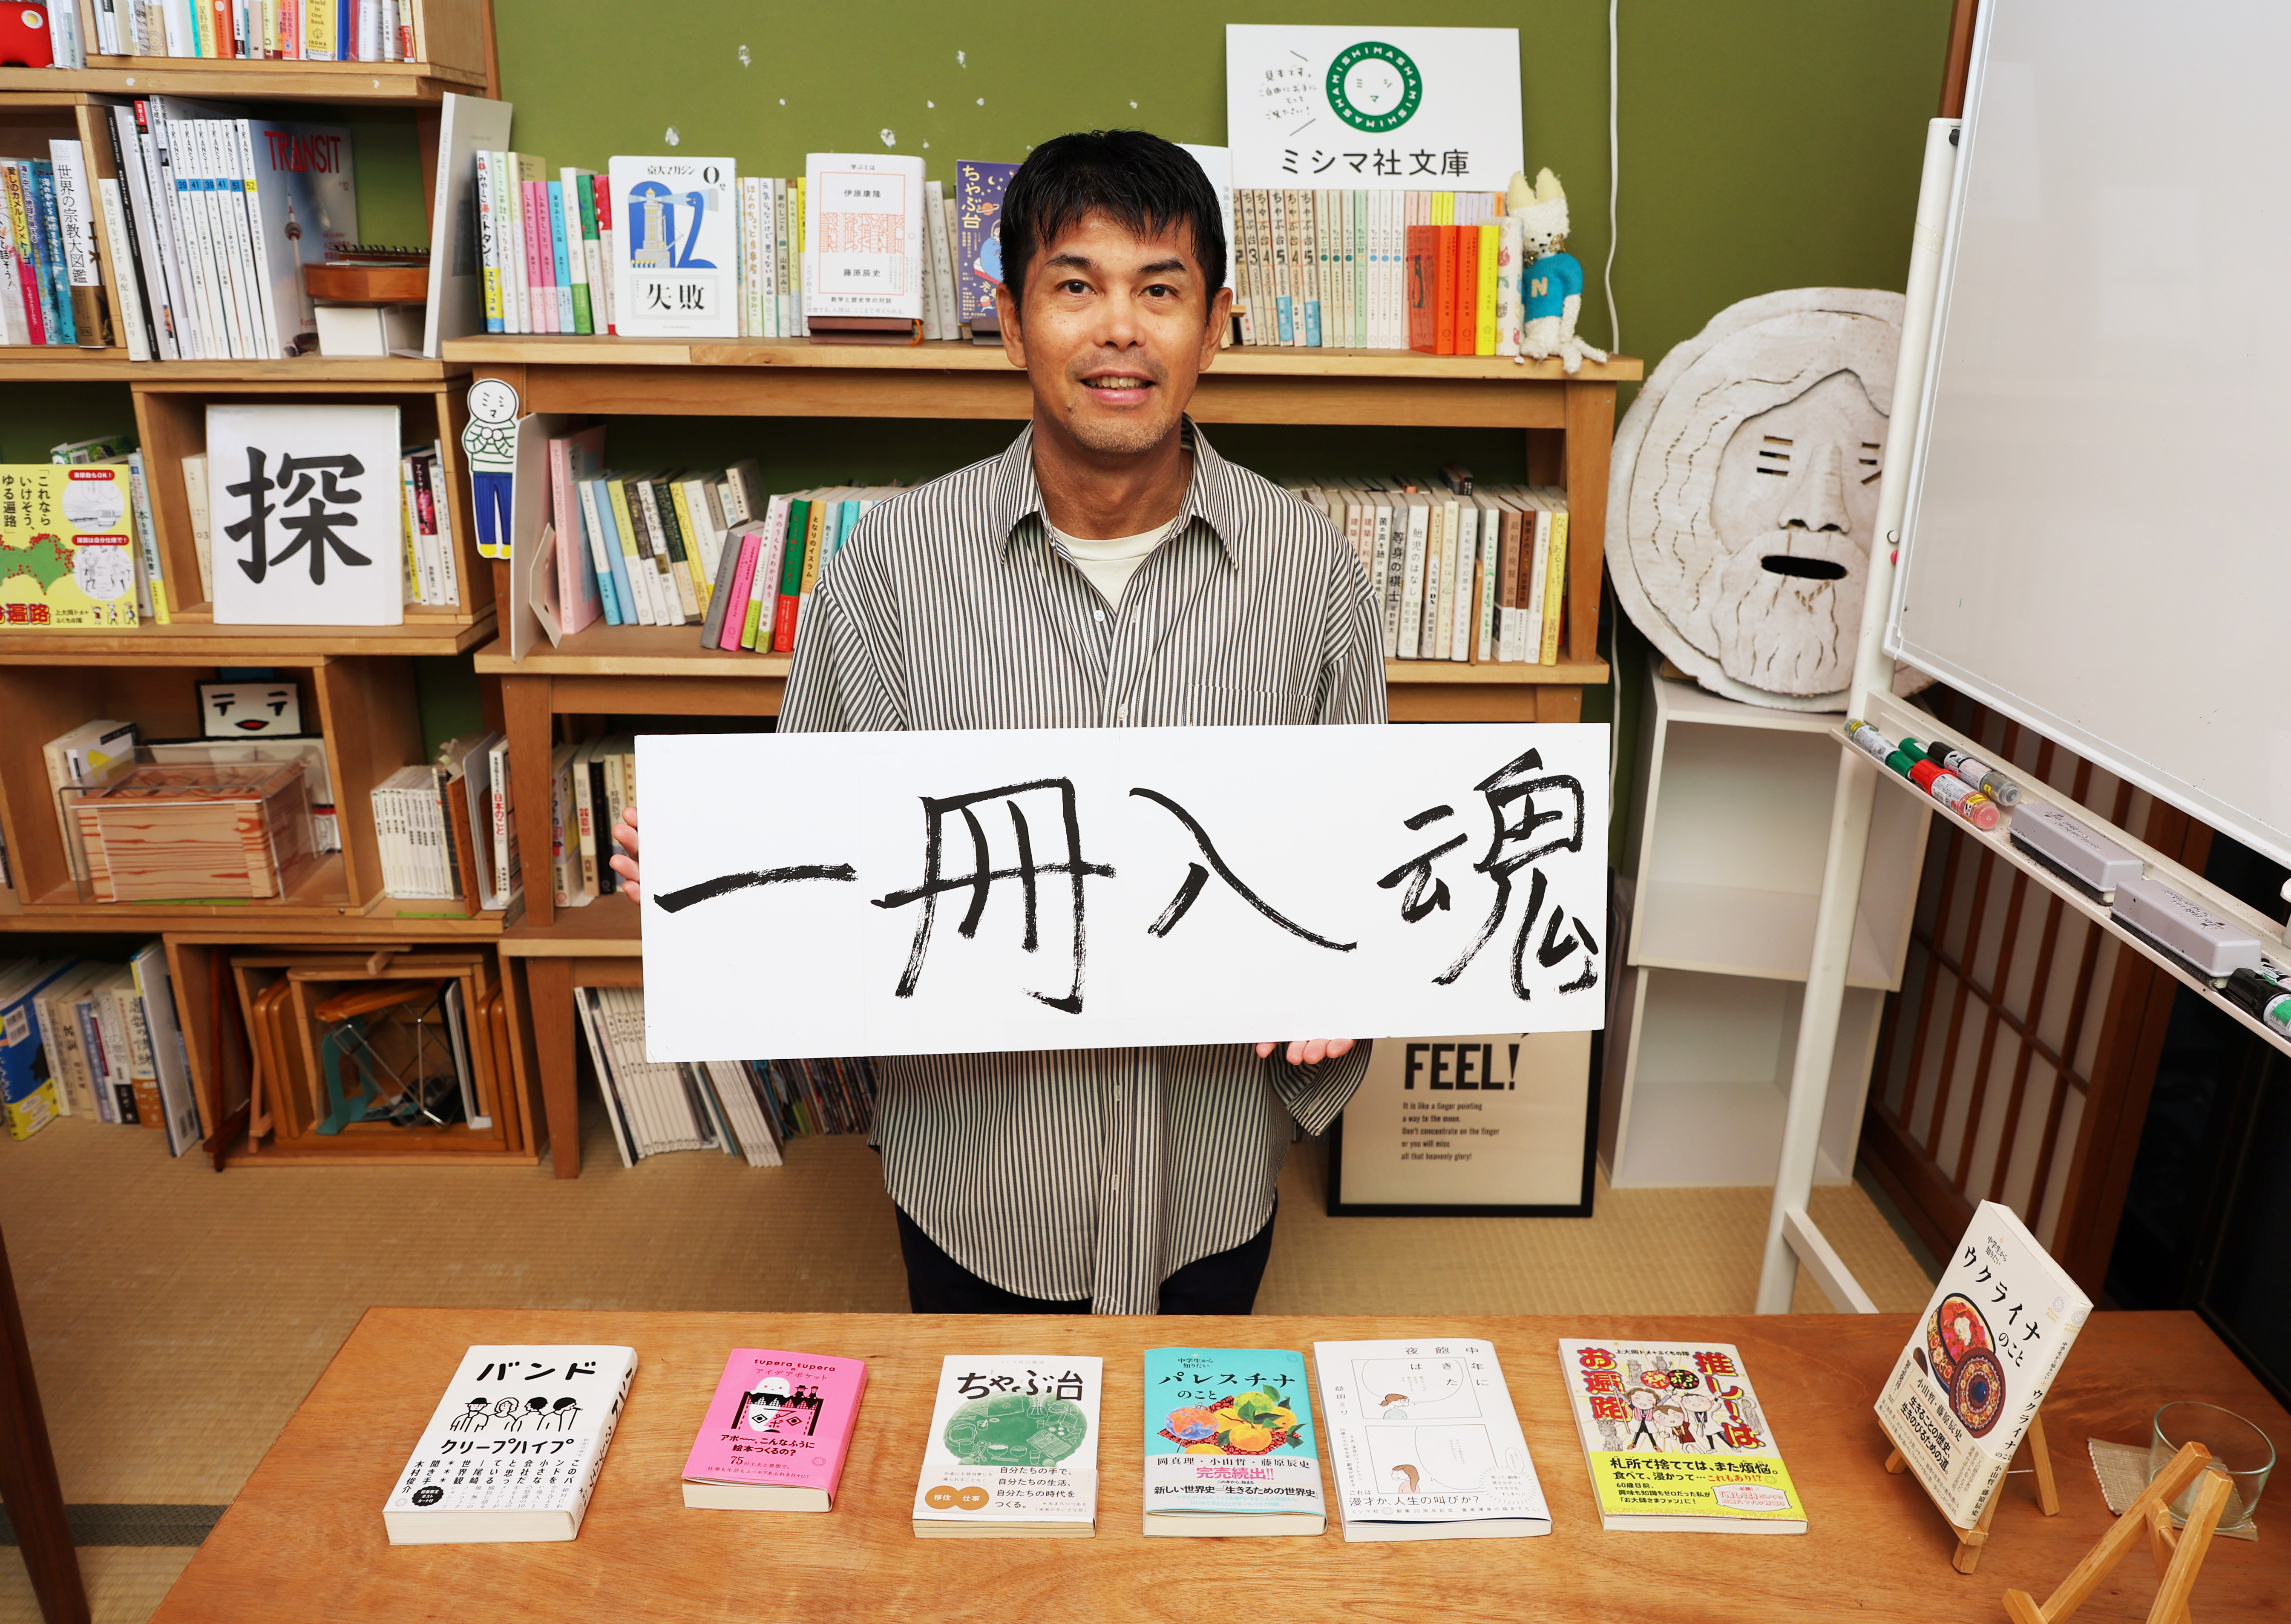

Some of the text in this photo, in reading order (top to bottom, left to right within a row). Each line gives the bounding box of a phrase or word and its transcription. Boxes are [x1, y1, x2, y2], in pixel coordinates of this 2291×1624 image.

[151, 98, 161, 126] 住宅建築
[170, 124, 181, 175] TRANSIT
[184, 124, 195, 174] TRANSIT
[198, 124, 209, 174] TRANSIT
[264, 131, 341, 174] TRANSIT
[1282, 149, 1470, 177] ミシマ社文庫
[178, 181, 187, 189] 39
[647, 166, 696, 176] 京大マガジン
[844, 190, 881, 198] 伊原康隆
[961, 164, 981, 230] ちゃぶ台
[57, 165, 88, 283] 世界の宗教大図鑑
[1243, 193, 1256, 245] ちゃぶ台
[1257, 193, 1269, 245] ちゃぶ台
[1272, 193, 1284, 245] ちゃぶ台
[647, 282, 705, 310] 失敗
[1531, 277, 1548, 298] N
[3, 475, 17, 534] ゆる遍路」
[20, 476, 35, 530] いけそう、
[37, 469, 51, 526] 「これなら
[224, 446, 372, 585] 探
[806, 516, 818, 577] となりのイスラム
[1376, 517, 1387, 566] 菌の声を聴け
[1508, 522, 1519, 579] 最初の晩餐
[1410, 528, 1422, 596] 胎児のはなし
[1387, 532, 1405, 633] 等身の棋士 北野新太
[1548, 619, 1557, 650] 星野概念
[494, 793, 505, 836] 日本のこと
[653, 747, 1598, 1013] 一冊入魂
[1405, 1043, 1520, 1090] FEEL!
[1437, 1103, 1455, 1111] finger
[1457, 1102, 1482, 1111] pointing
[1402, 1127, 1419, 1135] Don't
[1481, 1128, 1500, 1136] finger
[1410, 1141, 1421, 1149] you
[1426, 1153, 1453, 1161] heavenly
[1454, 1153, 1471, 1161] glory!
[1985, 1246, 2001, 1265] 知りたい
[1987, 1236, 2007, 1262] 中学生から
[1963, 1246, 2040, 1340] ウクライナ
[2046, 1312, 2057, 1323] BOOKS
[754, 1359, 836, 1372] tupera tupera
[1405, 1347, 1423, 1371] 夜は
[1999, 1333, 2023, 1367] のこと
[2044, 1342, 2067, 1380] 中学生から知りたい
[477, 1362, 596, 1381] バンド
[756, 1369, 827, 1381] アイデアポケット
[1158, 1371, 1295, 1388] パレスチナ
[1435, 1346, 1458, 1386] 飽きた
[1465, 1347, 1490, 1386] 中年に
[957, 1370, 1083, 1401] ちゃぶ台
[1177, 1390, 1217, 1400] のこと
[1334, 1386, 1348, 1415] 益田ミリ
[1577, 1348, 1632, 1422] お遍路
[1916, 1379, 1963, 1442] 小山哲・藤原辰史
[2005, 1390, 2043, 1450] ウクライナ
[1900, 1403, 1949, 1475] 生きのびるための道。
[1908, 1396, 1951, 1458] 生きることの歴史、
[440, 1438, 574, 1455] クリープハイプ
[732, 1444, 797, 1457] 絵本つくるの?
[1995, 1452, 2012, 1460] のこと
[707, 1466, 809, 1479] 仕事も生活もユーモアあふれる日々に!
[731, 1456, 790, 1469] 75の工夫と発想で、
[1000, 1466, 1072, 1475] 自分たちの手で、
[1157, 1458, 1310, 1469] 岡真理・小山哲・藤原辰史
[1196, 1467, 1275, 1480] 完売続出!!
[1610, 1458, 1779, 1475] 札所で捨てては、また煩悩。
[997, 1489, 1075, 1498] 自分たちの時代を
[998, 1478, 1071, 1486] 自分たちの生活、
[1971, 1465, 2001, 1516] 小山哲・藤原辰史
[1349, 1496, 1479, 1506] 漫才か、人生の叫びか?
